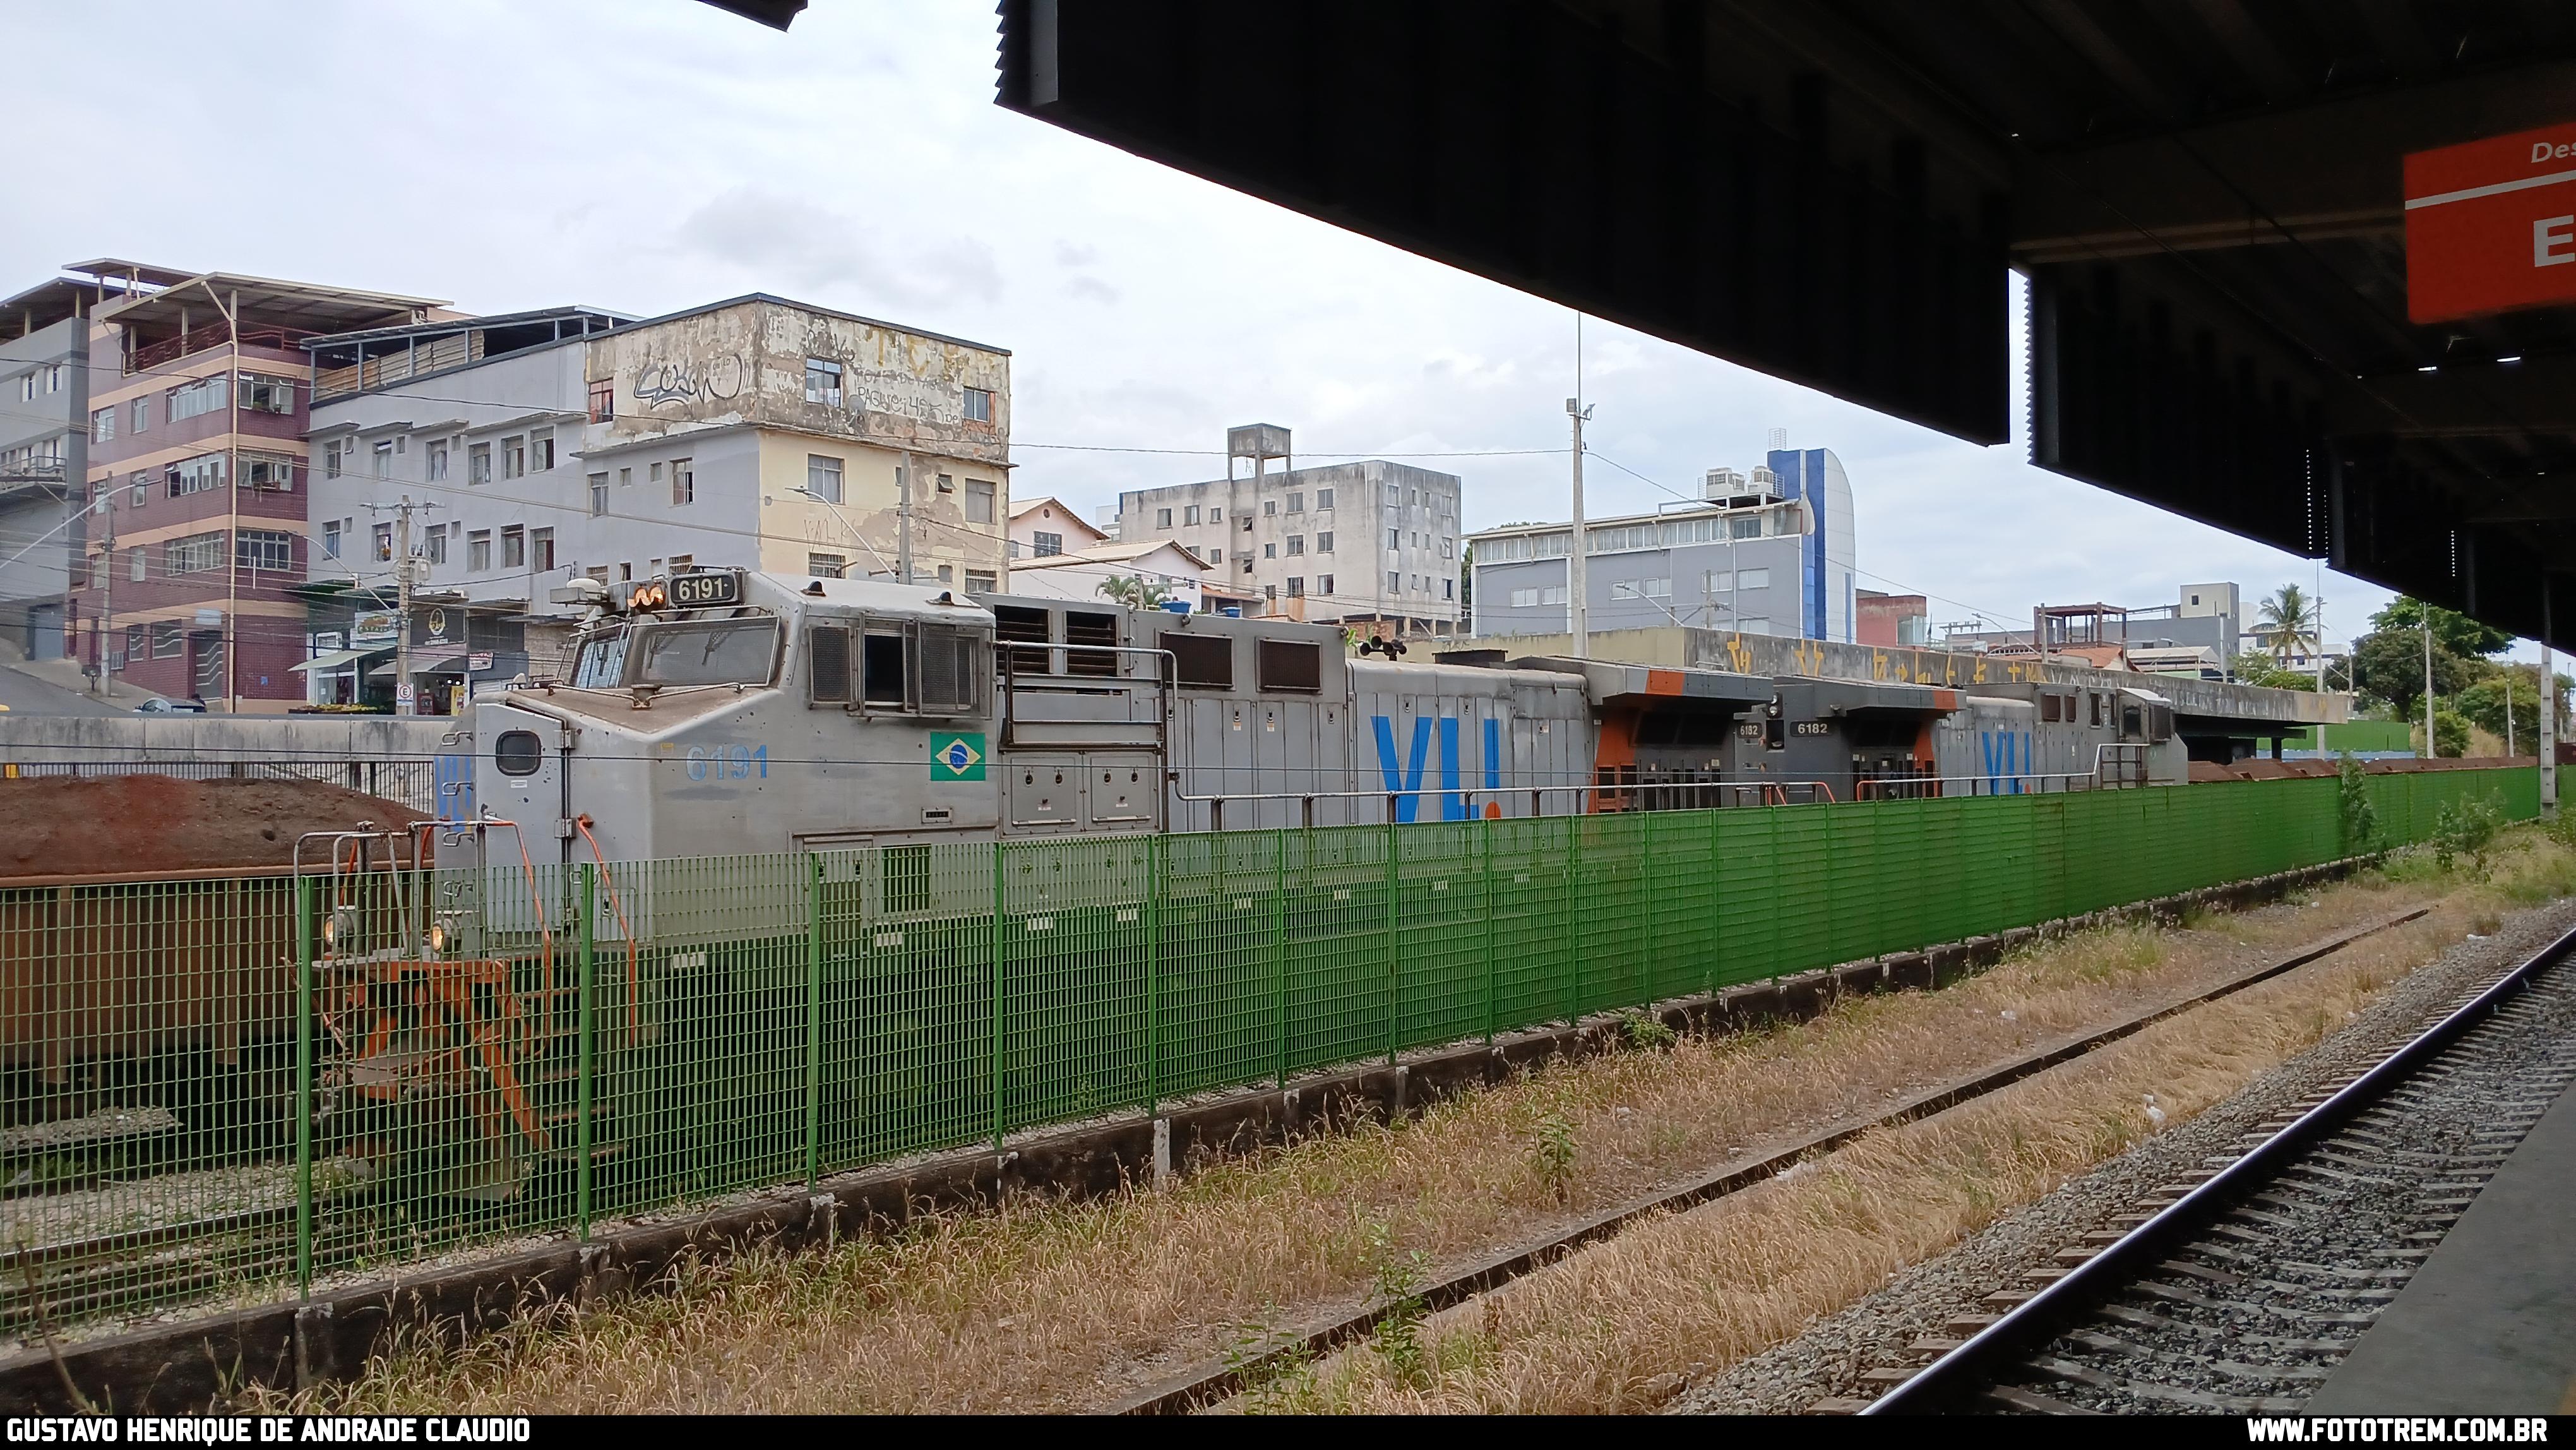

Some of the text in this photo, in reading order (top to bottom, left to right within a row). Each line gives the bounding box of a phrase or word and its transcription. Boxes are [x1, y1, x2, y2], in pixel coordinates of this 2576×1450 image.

[679, 577, 723, 600] 6191
[1740, 725, 1758, 735] 6182
[1798, 723, 1828, 734] 6182
[686, 744, 768, 781] 6191
